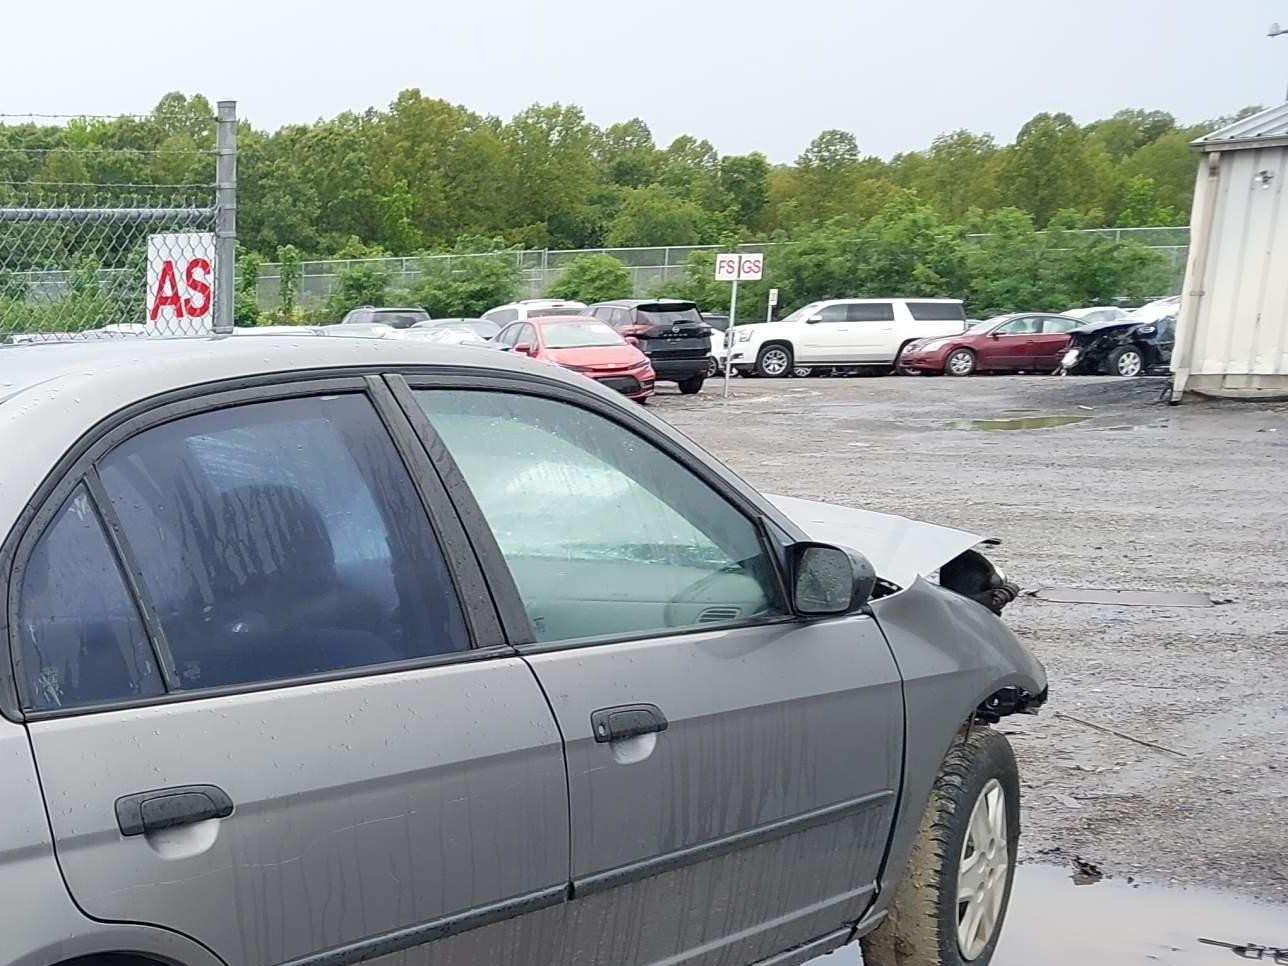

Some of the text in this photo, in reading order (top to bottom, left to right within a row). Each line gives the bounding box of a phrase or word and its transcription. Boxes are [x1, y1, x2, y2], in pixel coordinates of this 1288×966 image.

[718, 260, 761, 275] FS GS
[150, 257, 211, 320] AS
